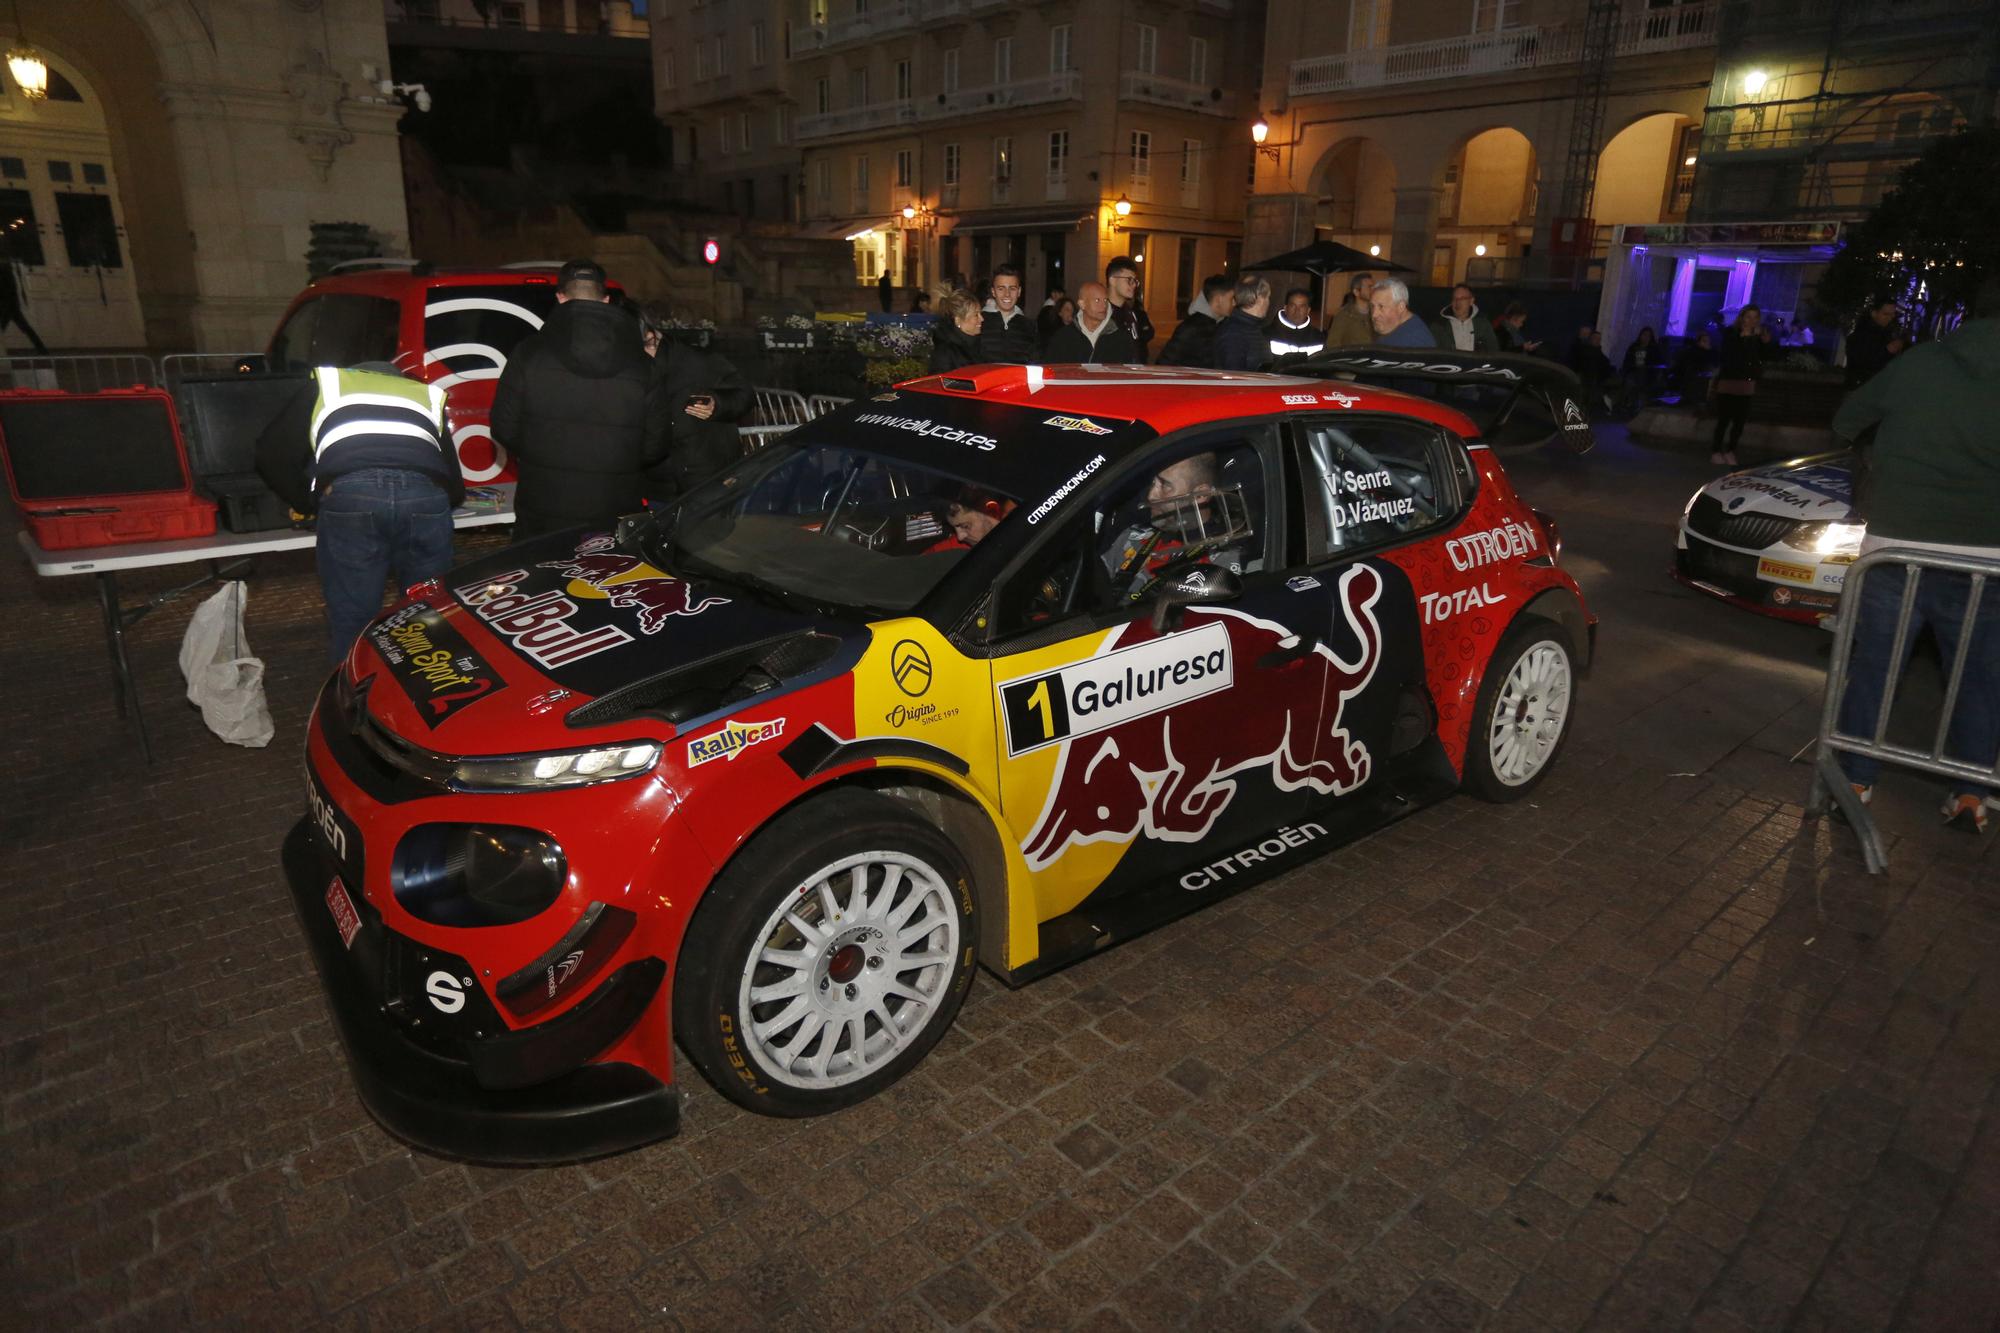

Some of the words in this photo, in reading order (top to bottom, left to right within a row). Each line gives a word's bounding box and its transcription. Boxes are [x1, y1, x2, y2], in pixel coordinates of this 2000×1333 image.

[854, 413, 998, 451] www.rallycar.es
[1051, 417, 1110, 435] Rallycar
[1027, 454, 1106, 525] CITROENRACING.COM
[1324, 473, 1343, 496] V.
[1344, 470, 1392, 493] Senra
[1446, 517, 1538, 572] CITROËN
[1760, 560, 1811, 580] PIRELLI
[410, 650, 474, 692] Sport
[1027, 681, 1054, 739] 1
[1072, 648, 1225, 716] Galuresa
[885, 703, 936, 728] Origins
[921, 713, 943, 726] SINCE
[943, 707, 960, 719] 1919
[690, 719, 784, 759] Rallycar
[305, 765, 346, 861] TROËN
[1179, 823, 1328, 890] CITROËN
